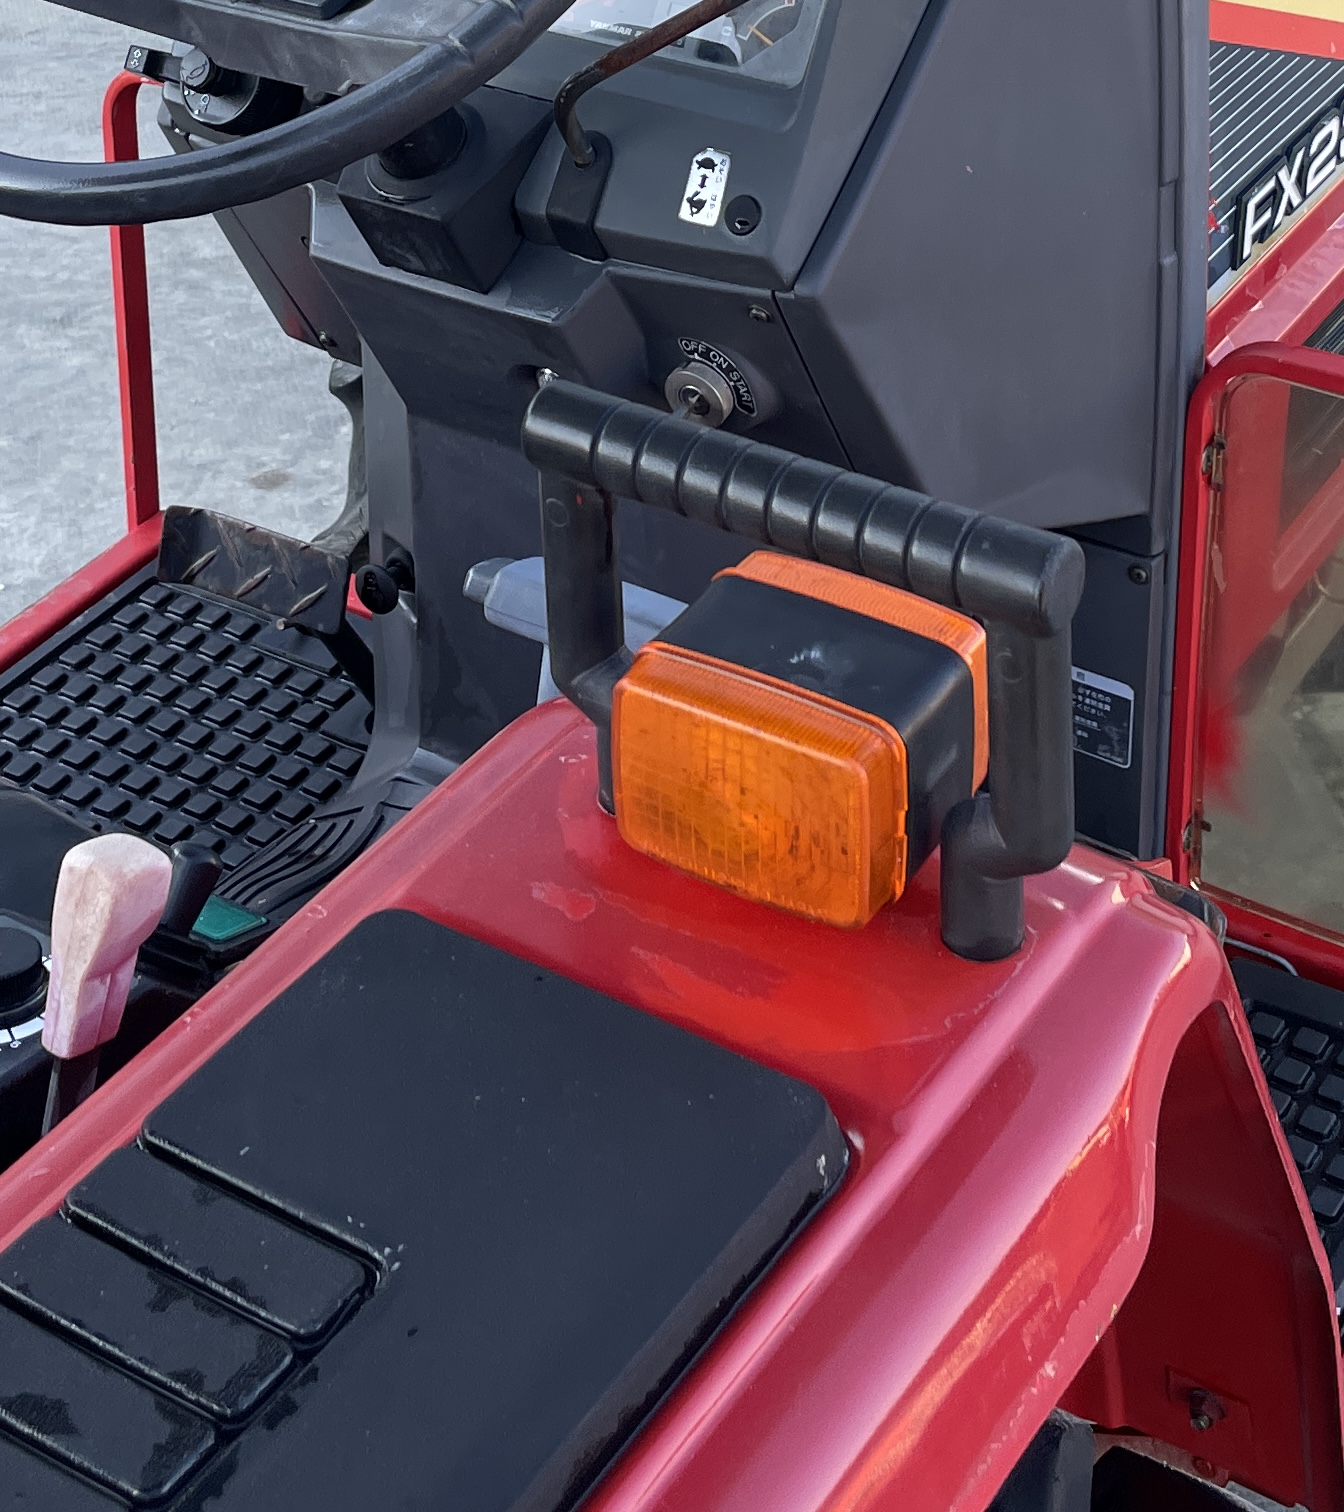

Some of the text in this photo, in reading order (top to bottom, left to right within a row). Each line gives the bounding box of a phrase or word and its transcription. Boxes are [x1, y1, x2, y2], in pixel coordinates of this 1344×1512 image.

[590, 19, 633, 36] YANMAR
[681, 340, 753, 409] OFF ON START
